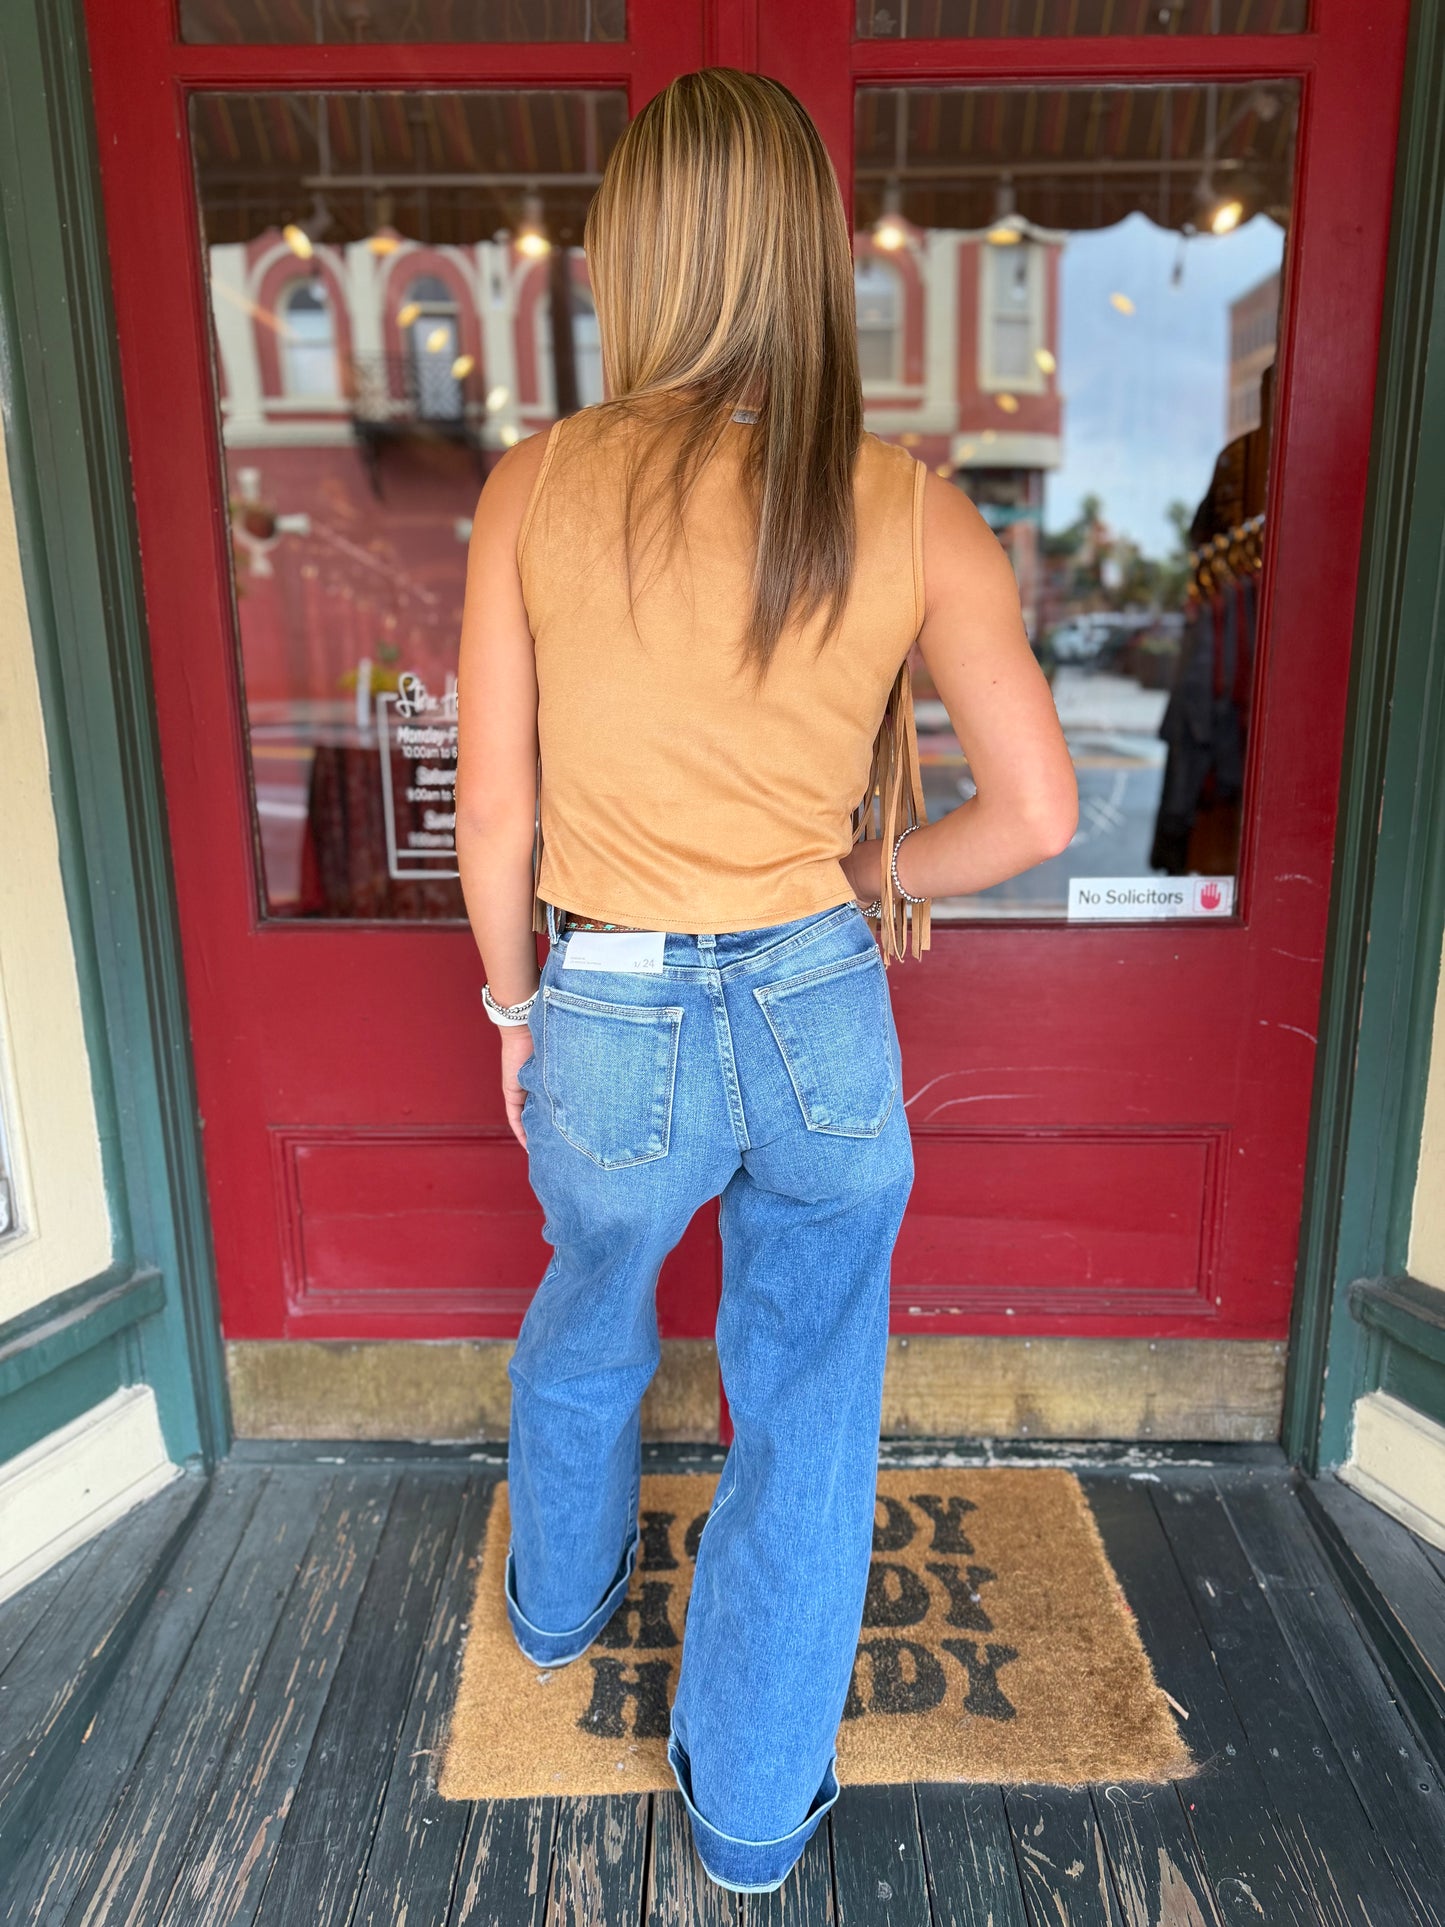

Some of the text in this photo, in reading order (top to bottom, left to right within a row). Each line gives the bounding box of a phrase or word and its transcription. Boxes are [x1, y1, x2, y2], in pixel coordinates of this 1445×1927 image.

[397, 726, 458, 746] Monday-F
[1079, 888, 1184, 905] No Solicitors
